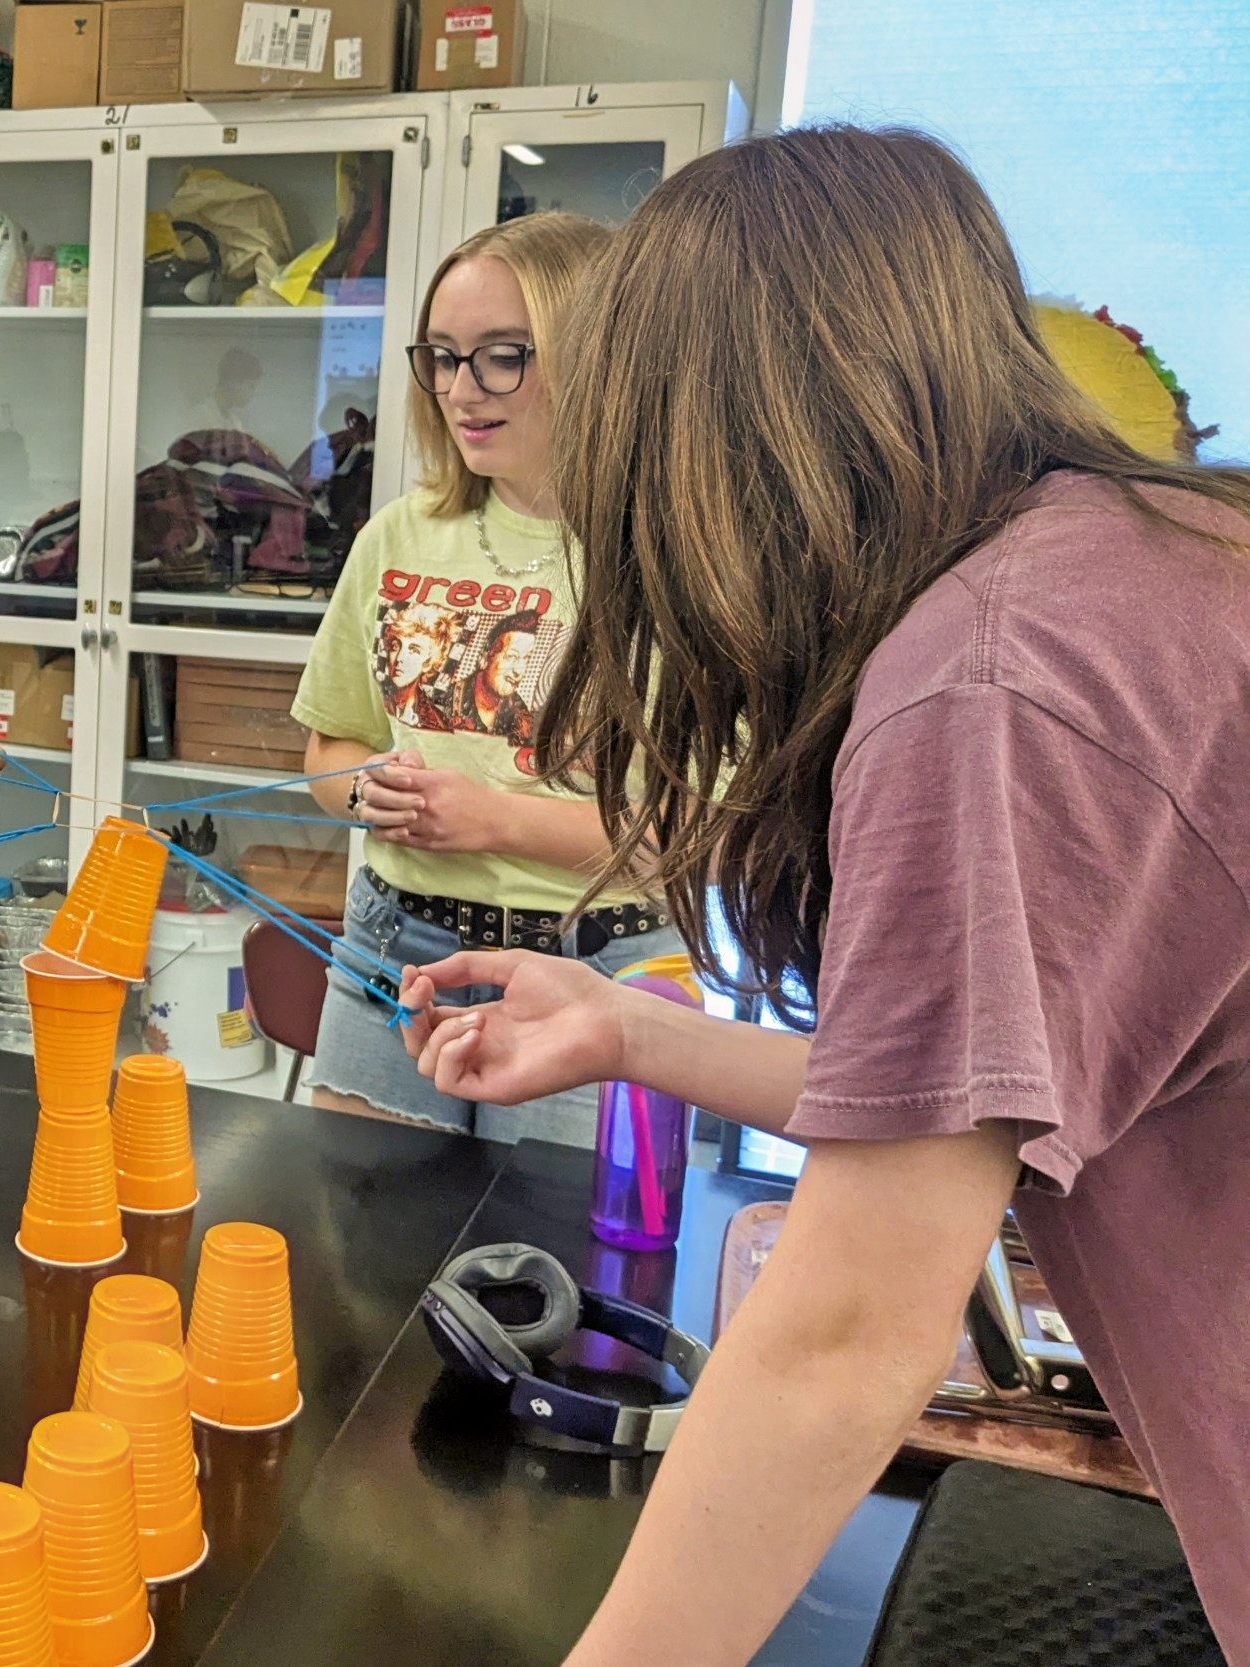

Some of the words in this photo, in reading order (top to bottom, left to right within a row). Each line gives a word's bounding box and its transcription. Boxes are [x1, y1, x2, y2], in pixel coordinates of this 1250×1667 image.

[575, 83, 598, 107] 16
[105, 104, 131, 125] 21
[378, 569, 552, 617] green
